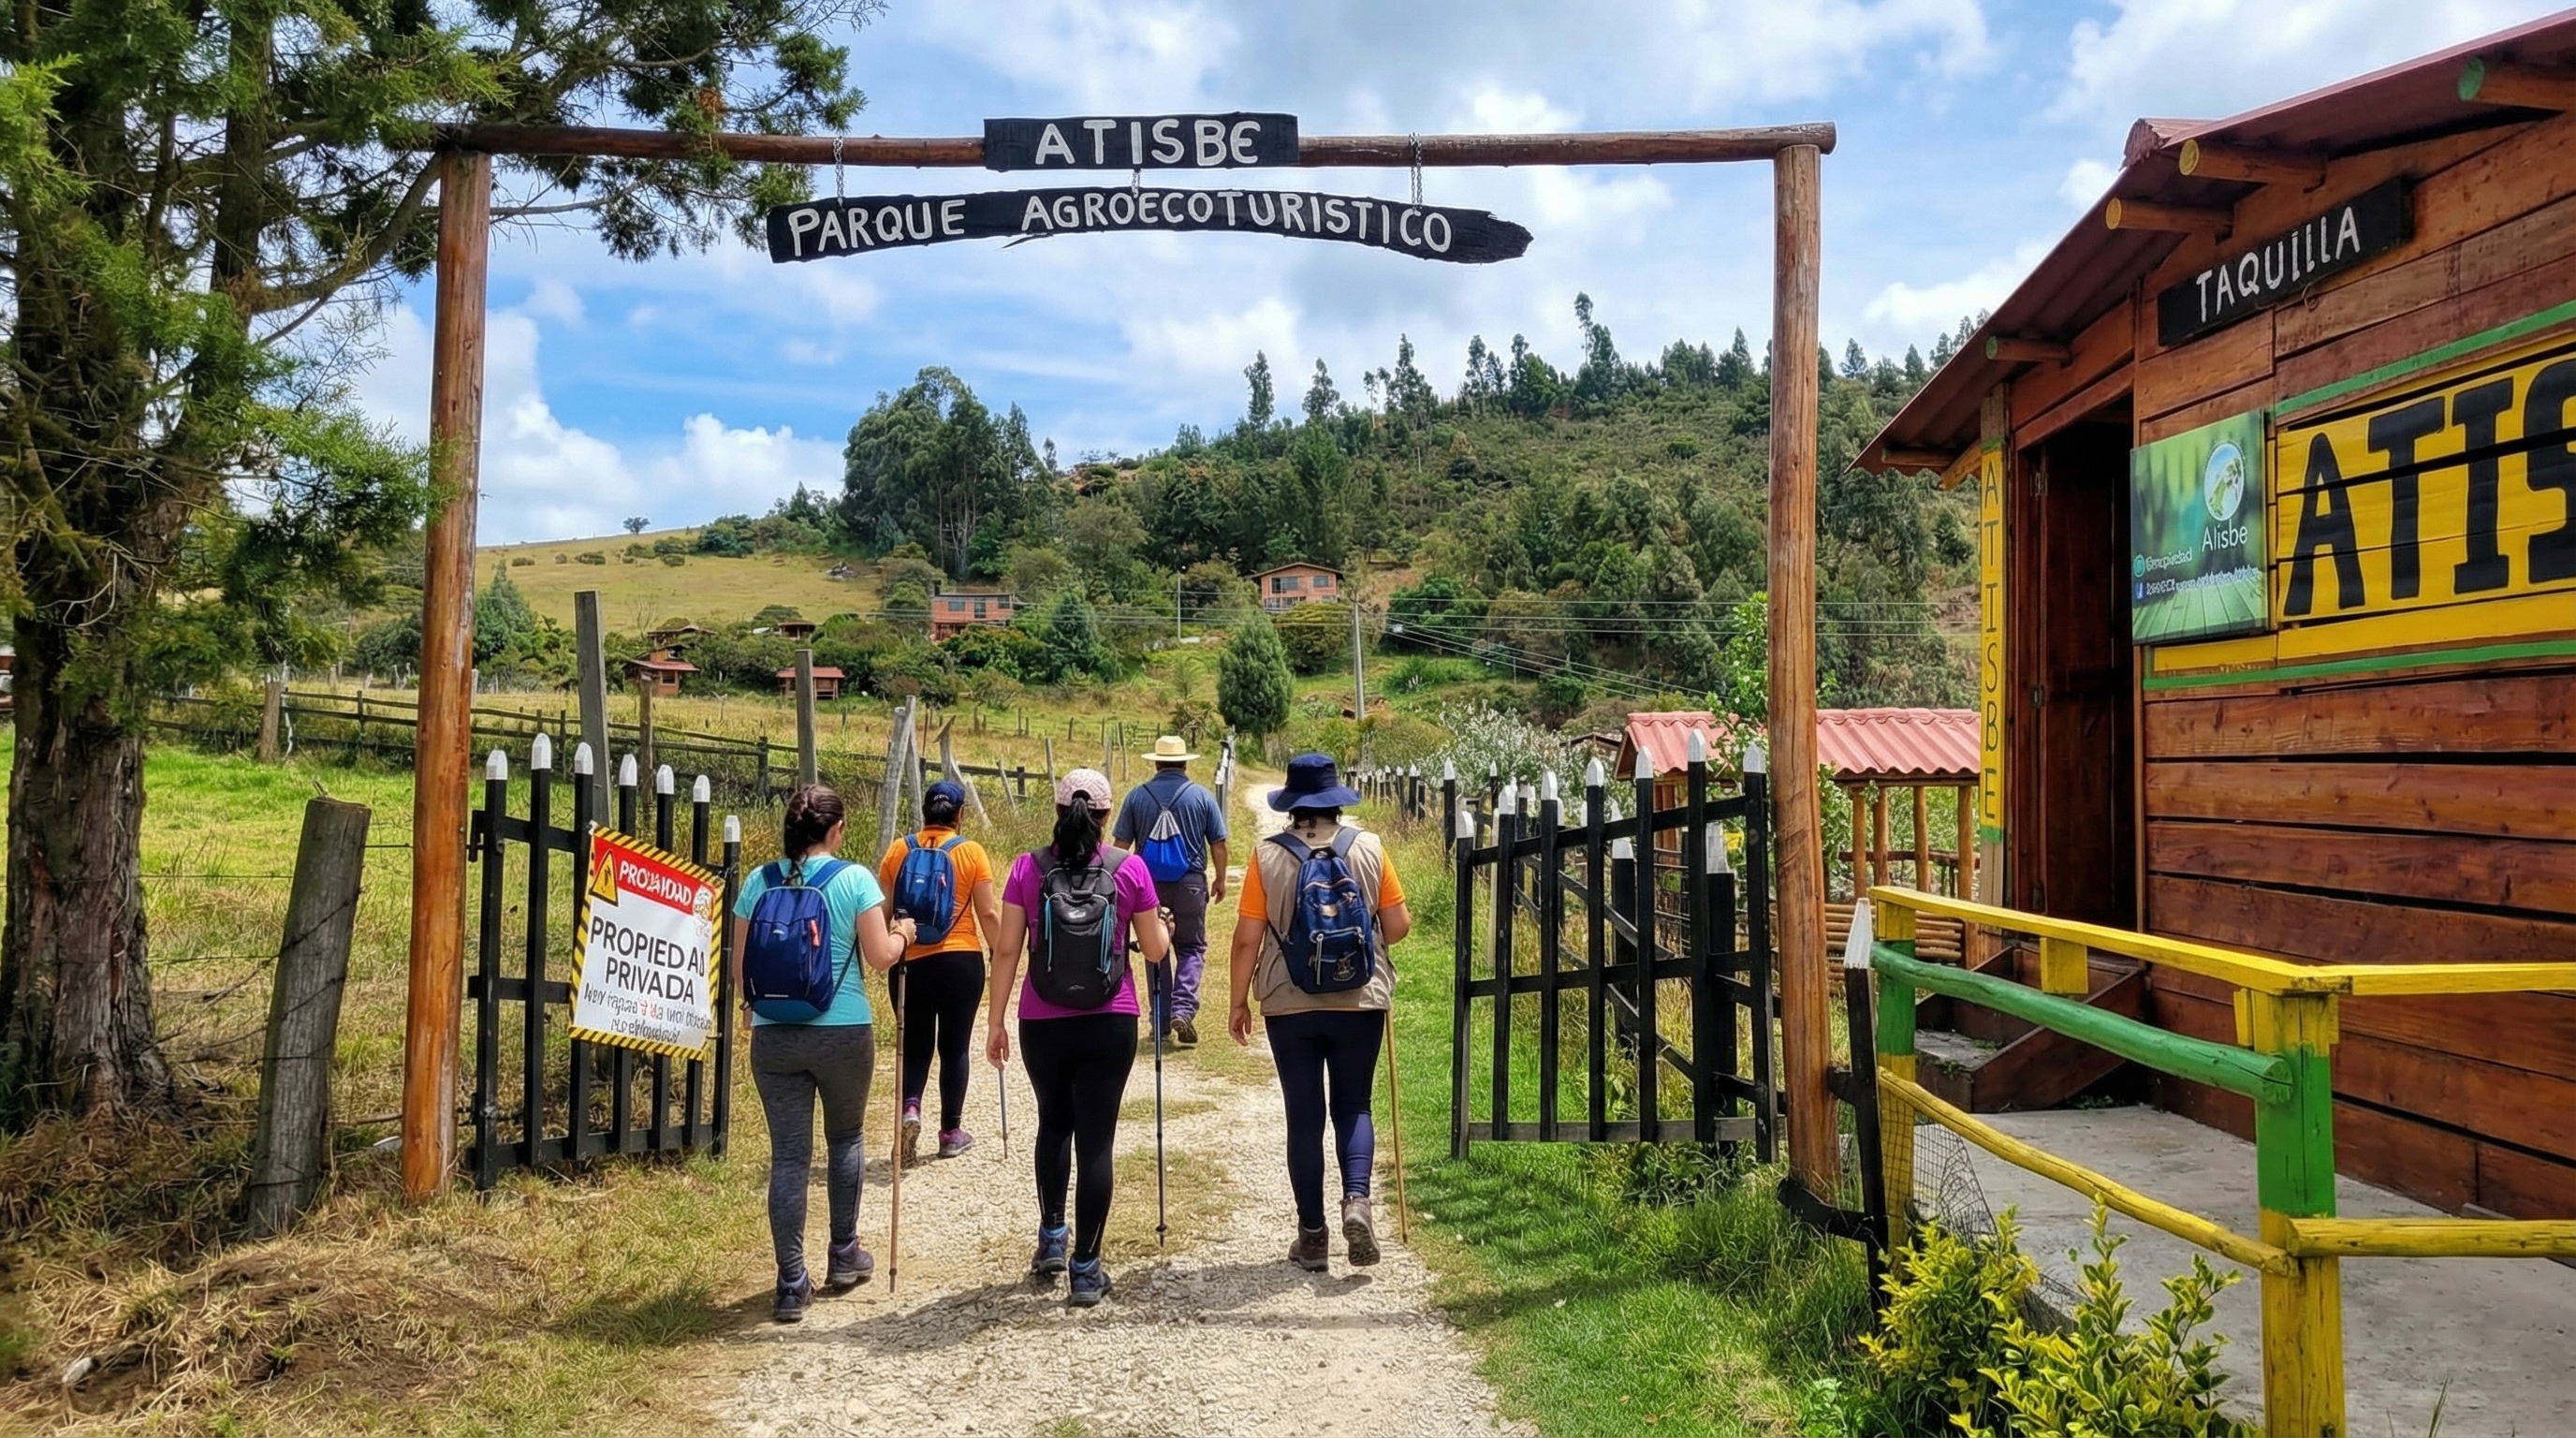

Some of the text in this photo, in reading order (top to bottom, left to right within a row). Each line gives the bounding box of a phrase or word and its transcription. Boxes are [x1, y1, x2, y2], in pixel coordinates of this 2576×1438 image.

[1034, 118, 1262, 166] ATISBE
[787, 190, 1452, 257] PARQUE AGROECOTURISTICO
[1983, 461, 2000, 820] ATISBE
[605, 956, 695, 1005] PRIVADA
